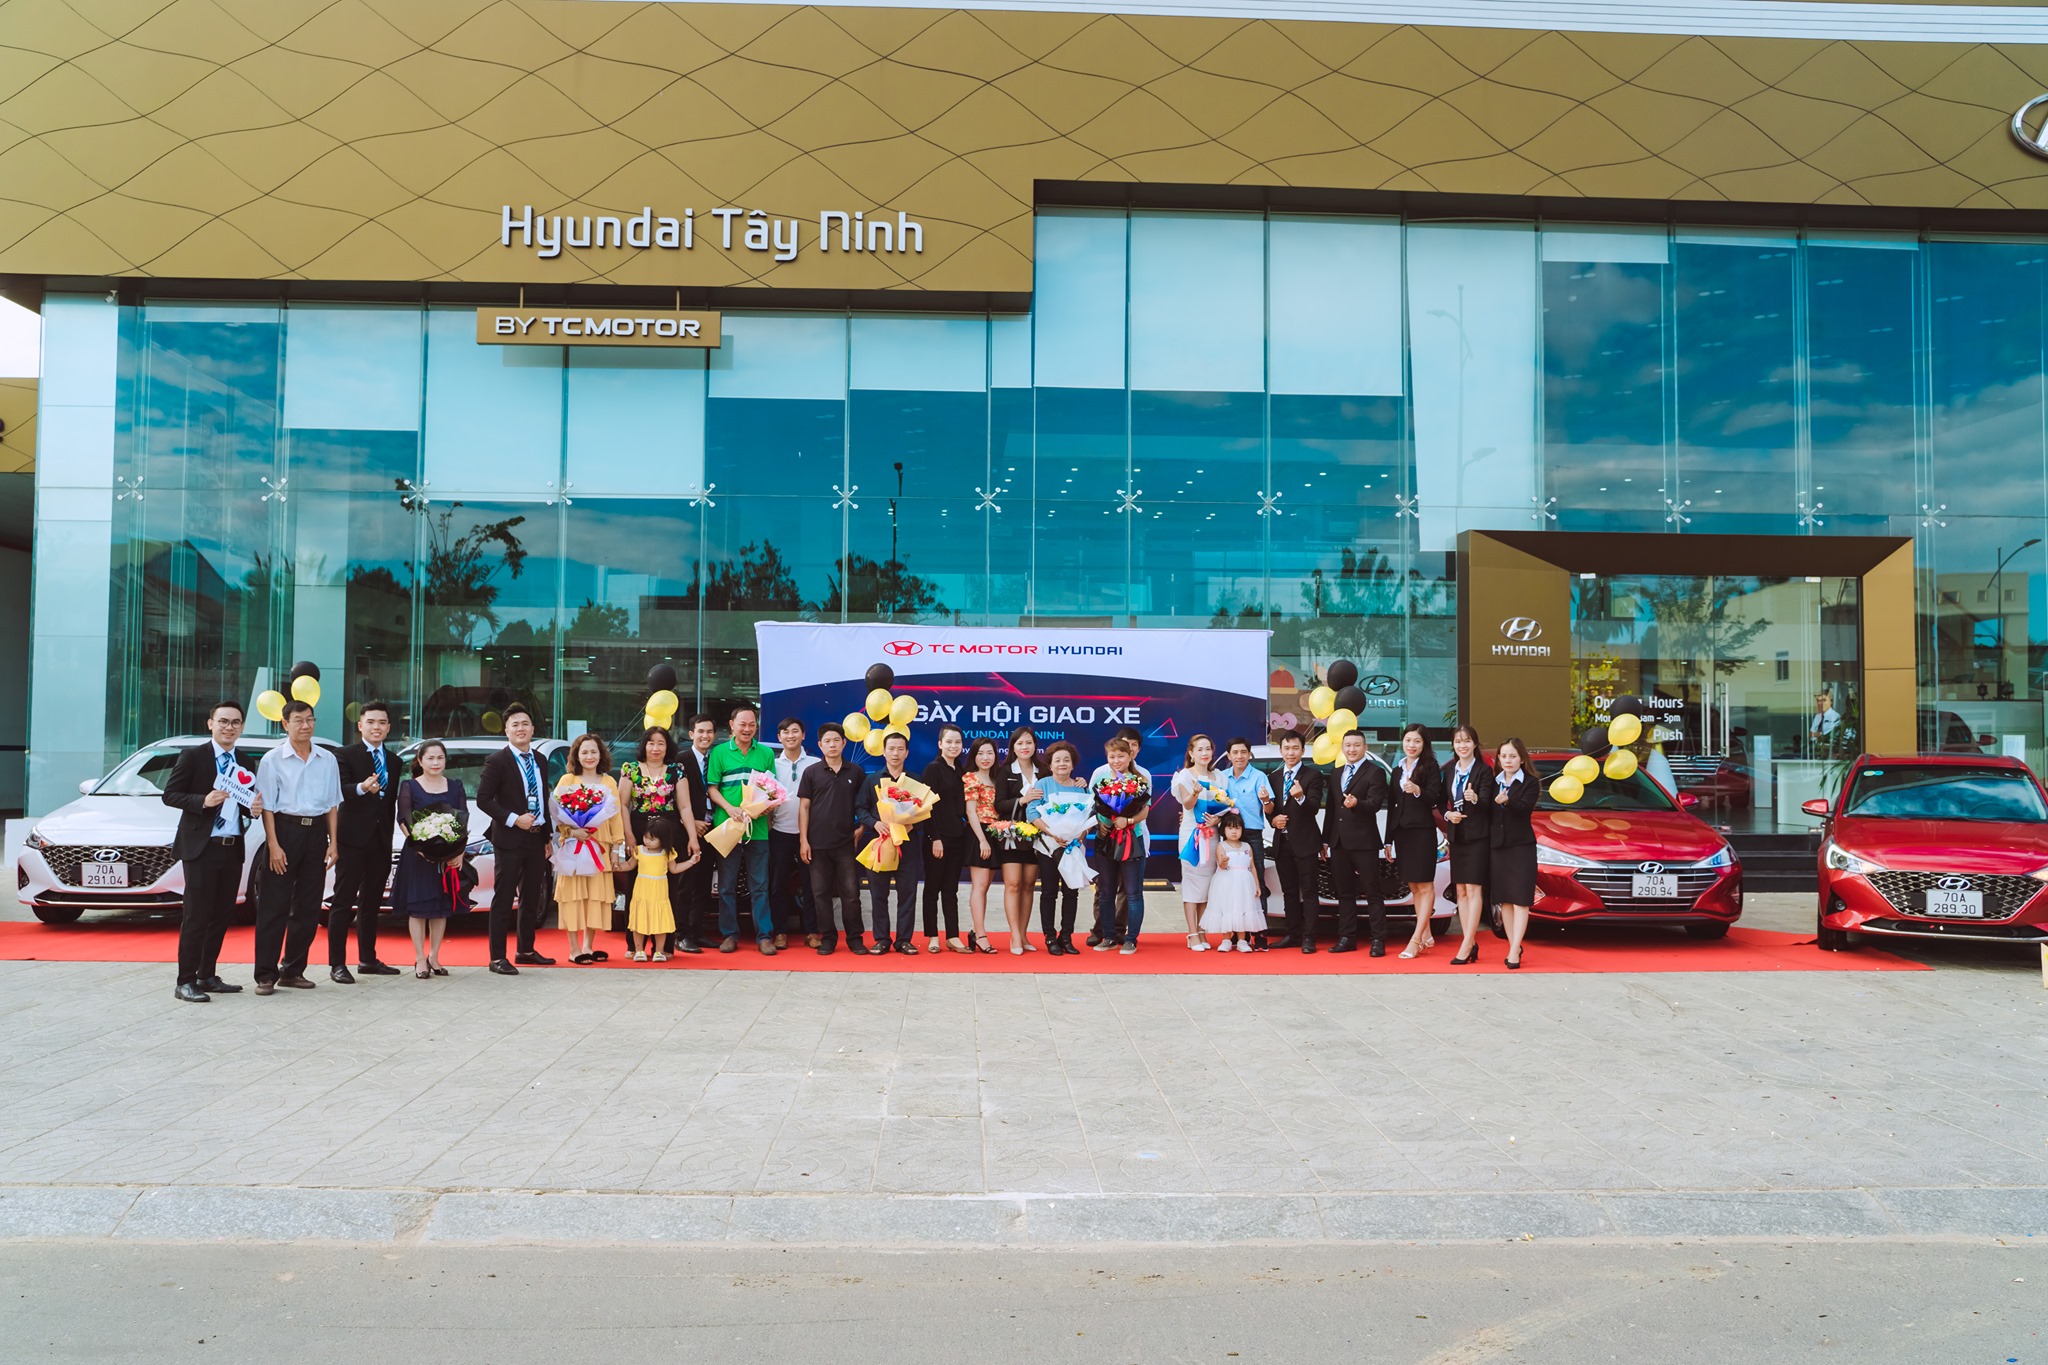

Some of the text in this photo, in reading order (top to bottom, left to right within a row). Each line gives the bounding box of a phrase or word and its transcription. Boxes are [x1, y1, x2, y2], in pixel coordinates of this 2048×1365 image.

[502, 205, 922, 261] Hyundai Tây Ninh
[495, 316, 536, 334] BY
[928, 644, 1123, 656] TC MOTOR HYUNDAI
[1492, 645, 1551, 656] HYUNDAI
[1649, 696, 1684, 709] Hours
[913, 701, 1141, 727] GÀY HỘI GIAO XE
[1664, 713, 1681, 724] 5pm
[962, 730, 1009, 739] YUNDAI
[1034, 731, 1065, 739] NINH
[1653, 729, 1683, 740] Push
[228, 766, 235, 777] I
[222, 777, 252, 797] HYUNDAI
[232, 792, 250, 806] NINH
[95, 864, 115, 874] 70A
[87, 875, 123, 885] 291.04
[1646, 875, 1665, 885] 70A
[1638, 886, 1673, 896] 290.94
[1943, 892, 1966, 903] 70A
[1933, 903, 1976, 915] 289.30
